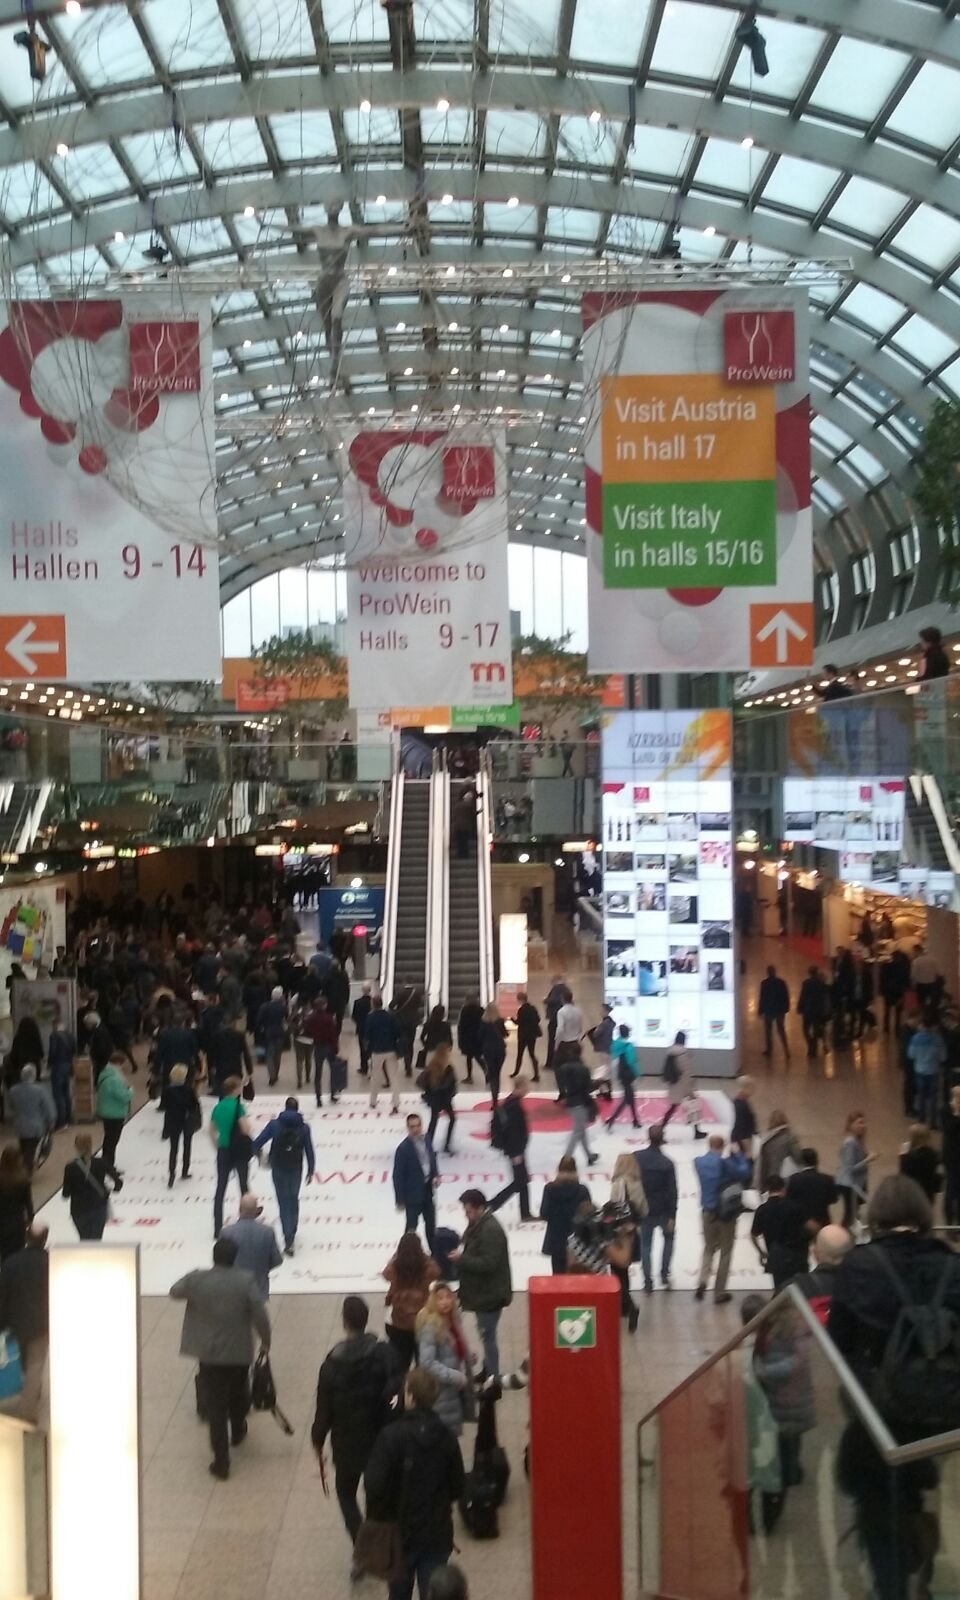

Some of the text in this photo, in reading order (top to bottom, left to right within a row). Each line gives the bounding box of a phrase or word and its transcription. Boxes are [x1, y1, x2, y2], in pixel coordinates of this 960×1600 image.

[728, 365, 793, 380] ProWein
[614, 395, 757, 423] Visit Austria
[616, 433, 716, 460] in hall 17
[613, 503, 722, 535] Visit Italy
[10, 521, 79, 548] Halls
[11, 553, 99, 581] Hallen
[614, 539, 764, 568] in halls 15/16
[359, 561, 486, 584] Welcome to
[358, 593, 451, 616] ProWein
[359, 630, 409, 651] Halls
